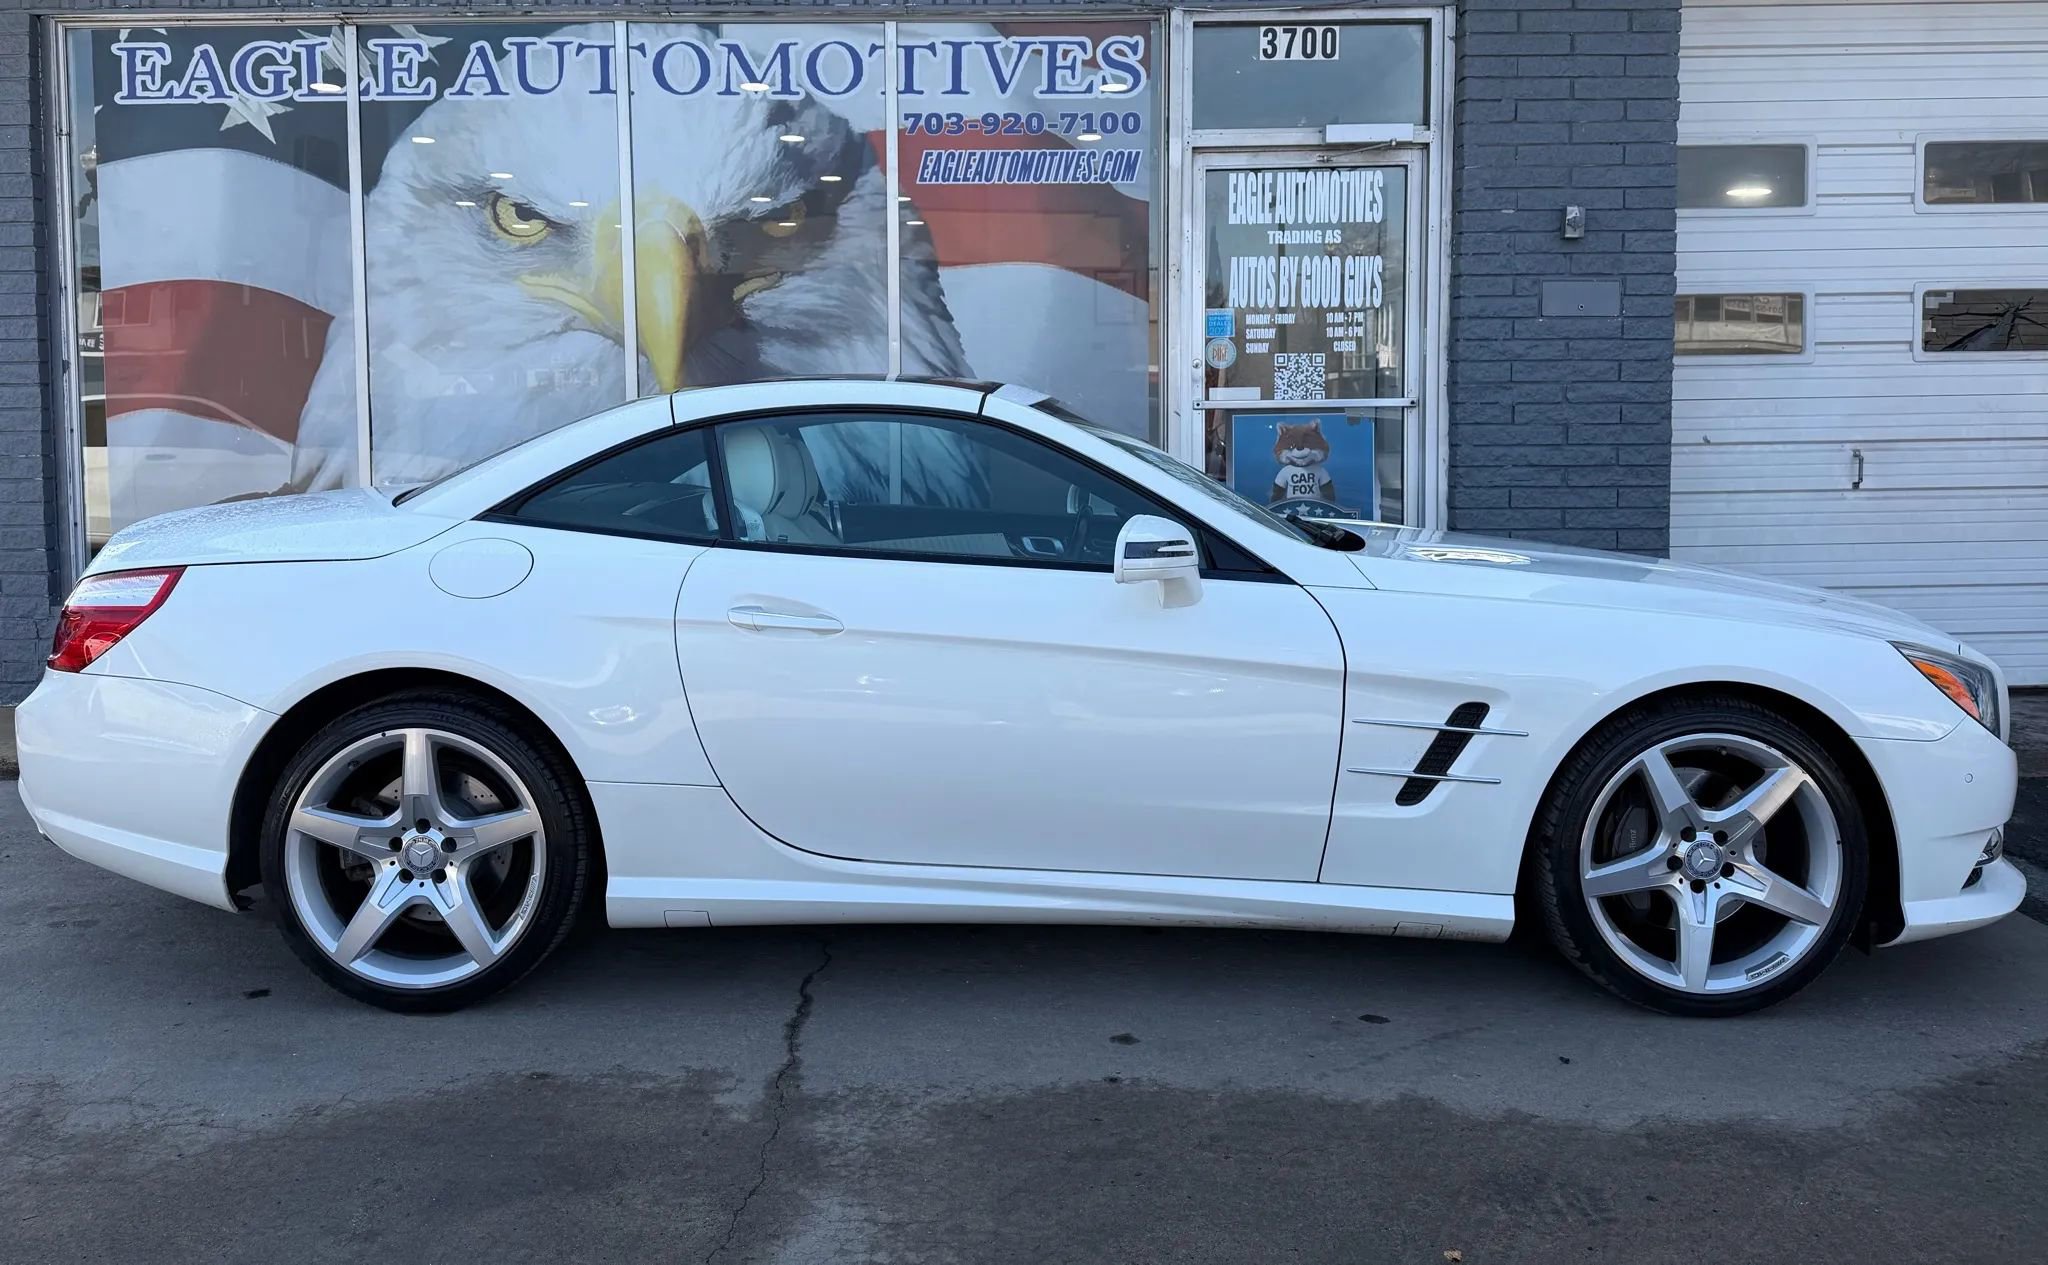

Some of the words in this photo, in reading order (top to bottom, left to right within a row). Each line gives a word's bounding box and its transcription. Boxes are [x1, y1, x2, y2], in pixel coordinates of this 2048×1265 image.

[1262, 27, 1337, 59] 3700
[113, 39, 434, 102] EAGLE
[450, 36, 1146, 101] AUTOMOTIVES
[903, 112, 1142, 135] 703-920-7100
[917, 149, 1143, 184] EAGLEAUTOMOTIVES.COM
[1228, 172, 1273, 225] EAGLE
[1275, 170, 1384, 225] AUTOMOTIVES
[1267, 230, 1323, 245] TRADING
[1324, 229, 1342, 244] AS
[1228, 256, 1277, 309] AUTOS
[1279, 256, 1299, 308] BY
[1301, 255, 1342, 309] GOOD
[1344, 255, 1383, 309] GUYS
[1245, 313, 1271, 325] MONDAY
[1275, 313, 1296, 324] FRIDAY
[1245, 328, 1277, 340] SATURDAY
[1245, 342, 1270, 354] SUNDAY
[1333, 340, 1357, 352] CLOSED
[1291, 473, 1315, 484] CAR
[1292, 484, 1315, 495] FOX
